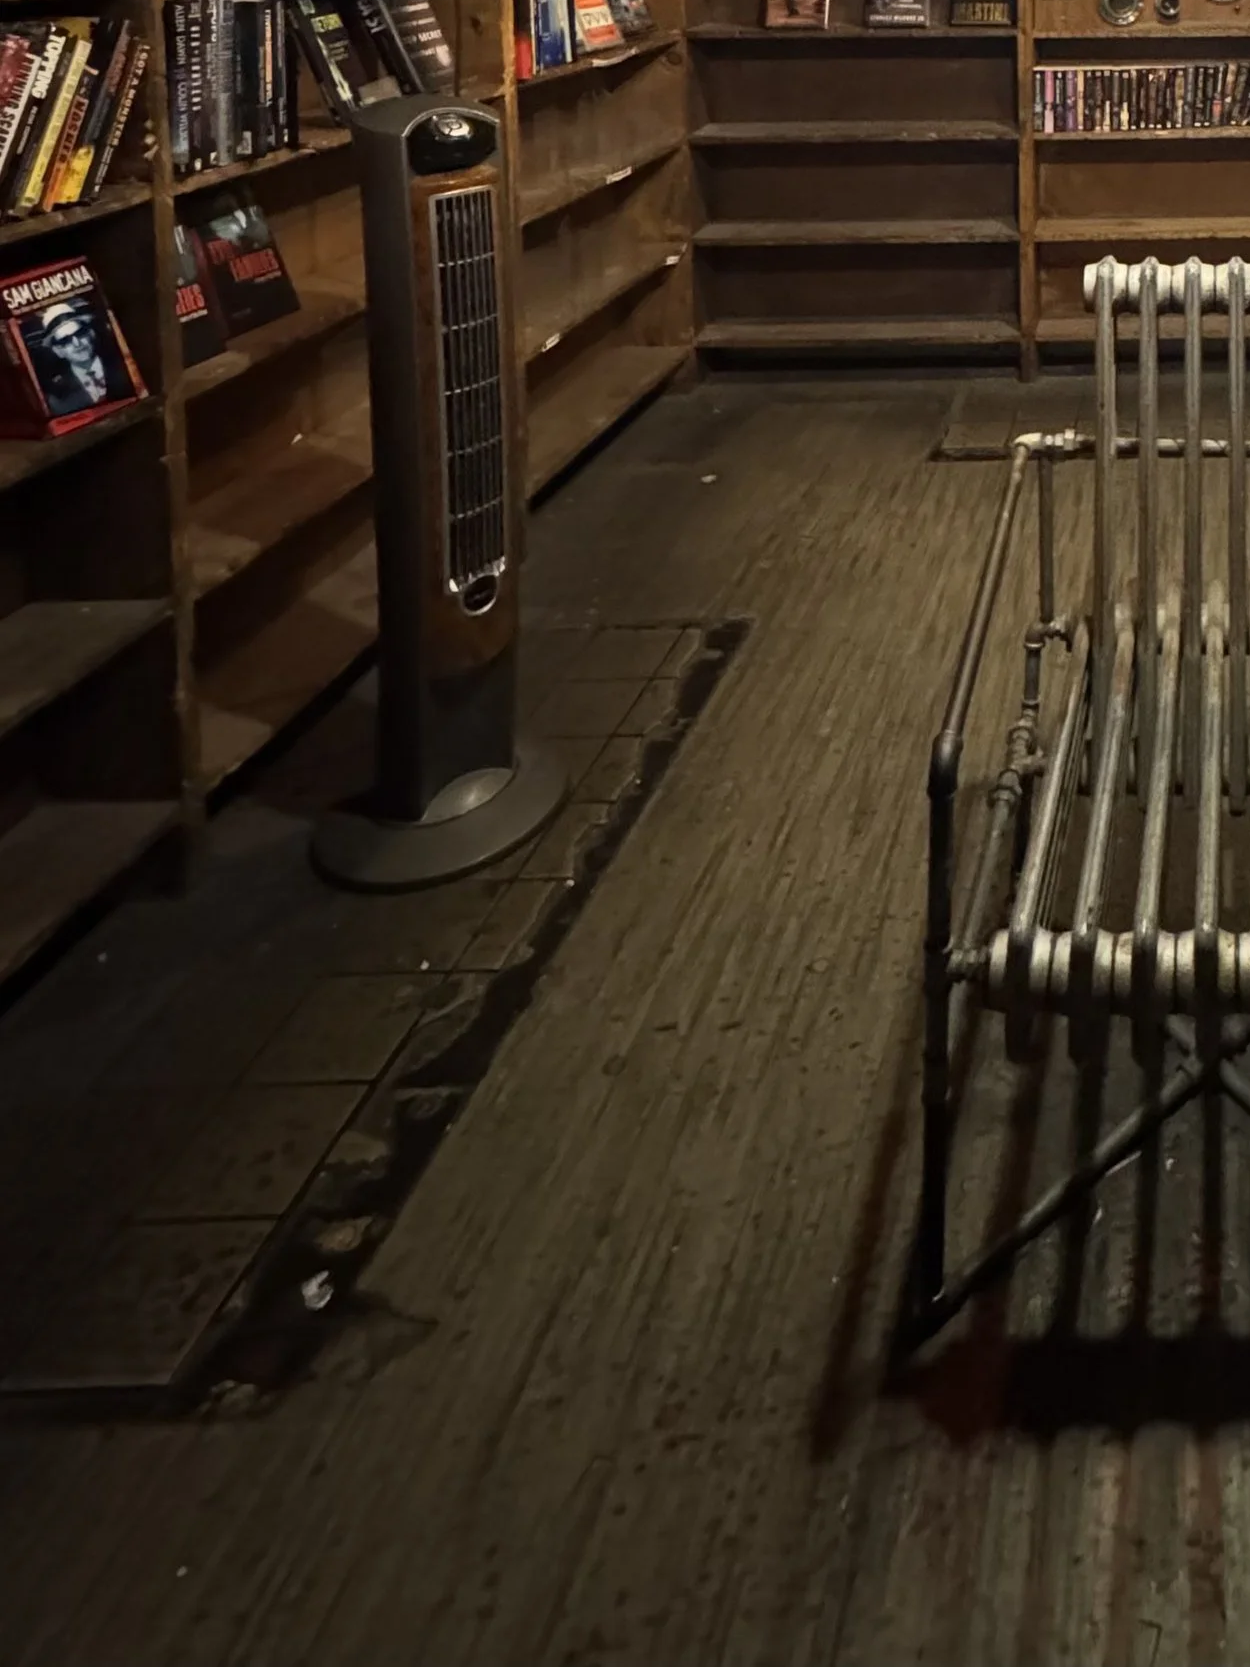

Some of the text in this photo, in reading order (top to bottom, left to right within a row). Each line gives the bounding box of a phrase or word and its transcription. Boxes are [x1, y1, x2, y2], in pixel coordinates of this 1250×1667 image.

[174, 4, 187, 32] ALIEN
[176, 34, 187, 66] DAWN
[2, 285, 33, 309] SAM
[32, 264, 95, 301] GIANCANA
